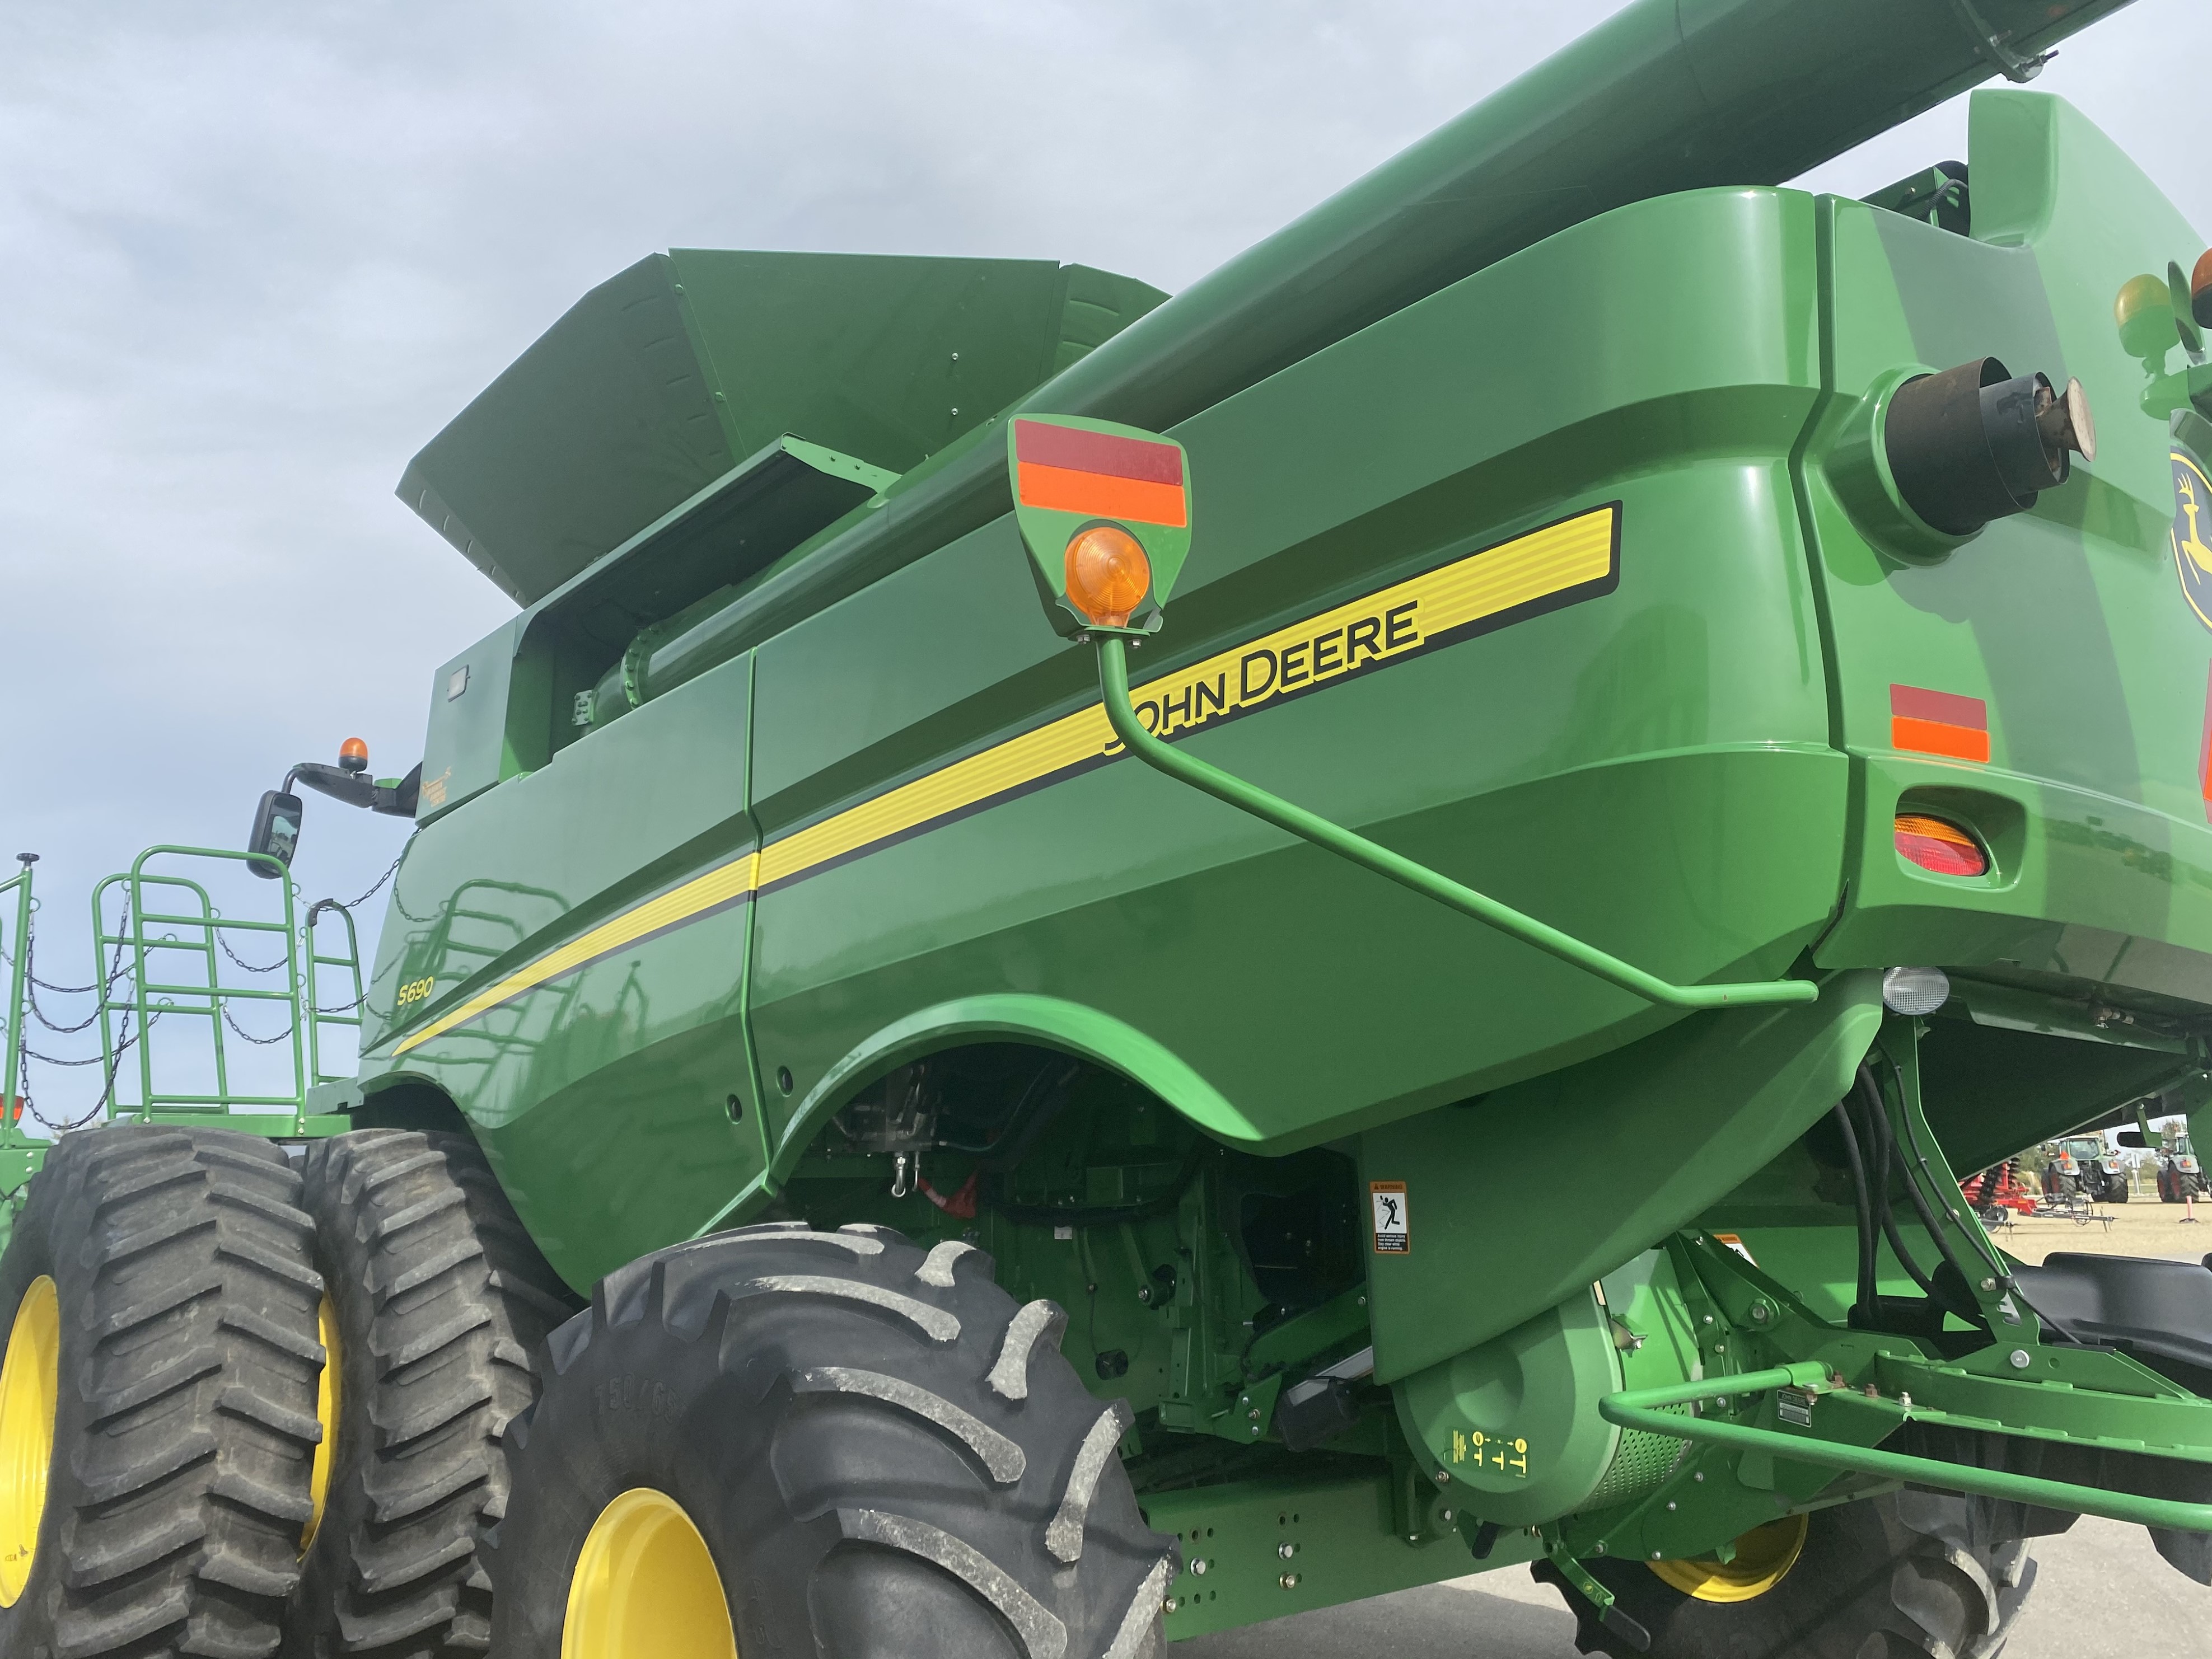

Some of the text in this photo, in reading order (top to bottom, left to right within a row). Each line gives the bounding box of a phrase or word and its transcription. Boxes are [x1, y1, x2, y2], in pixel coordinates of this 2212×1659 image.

[1104, 599, 1418, 751] OHN DEERE
[397, 976, 434, 1006] S690
